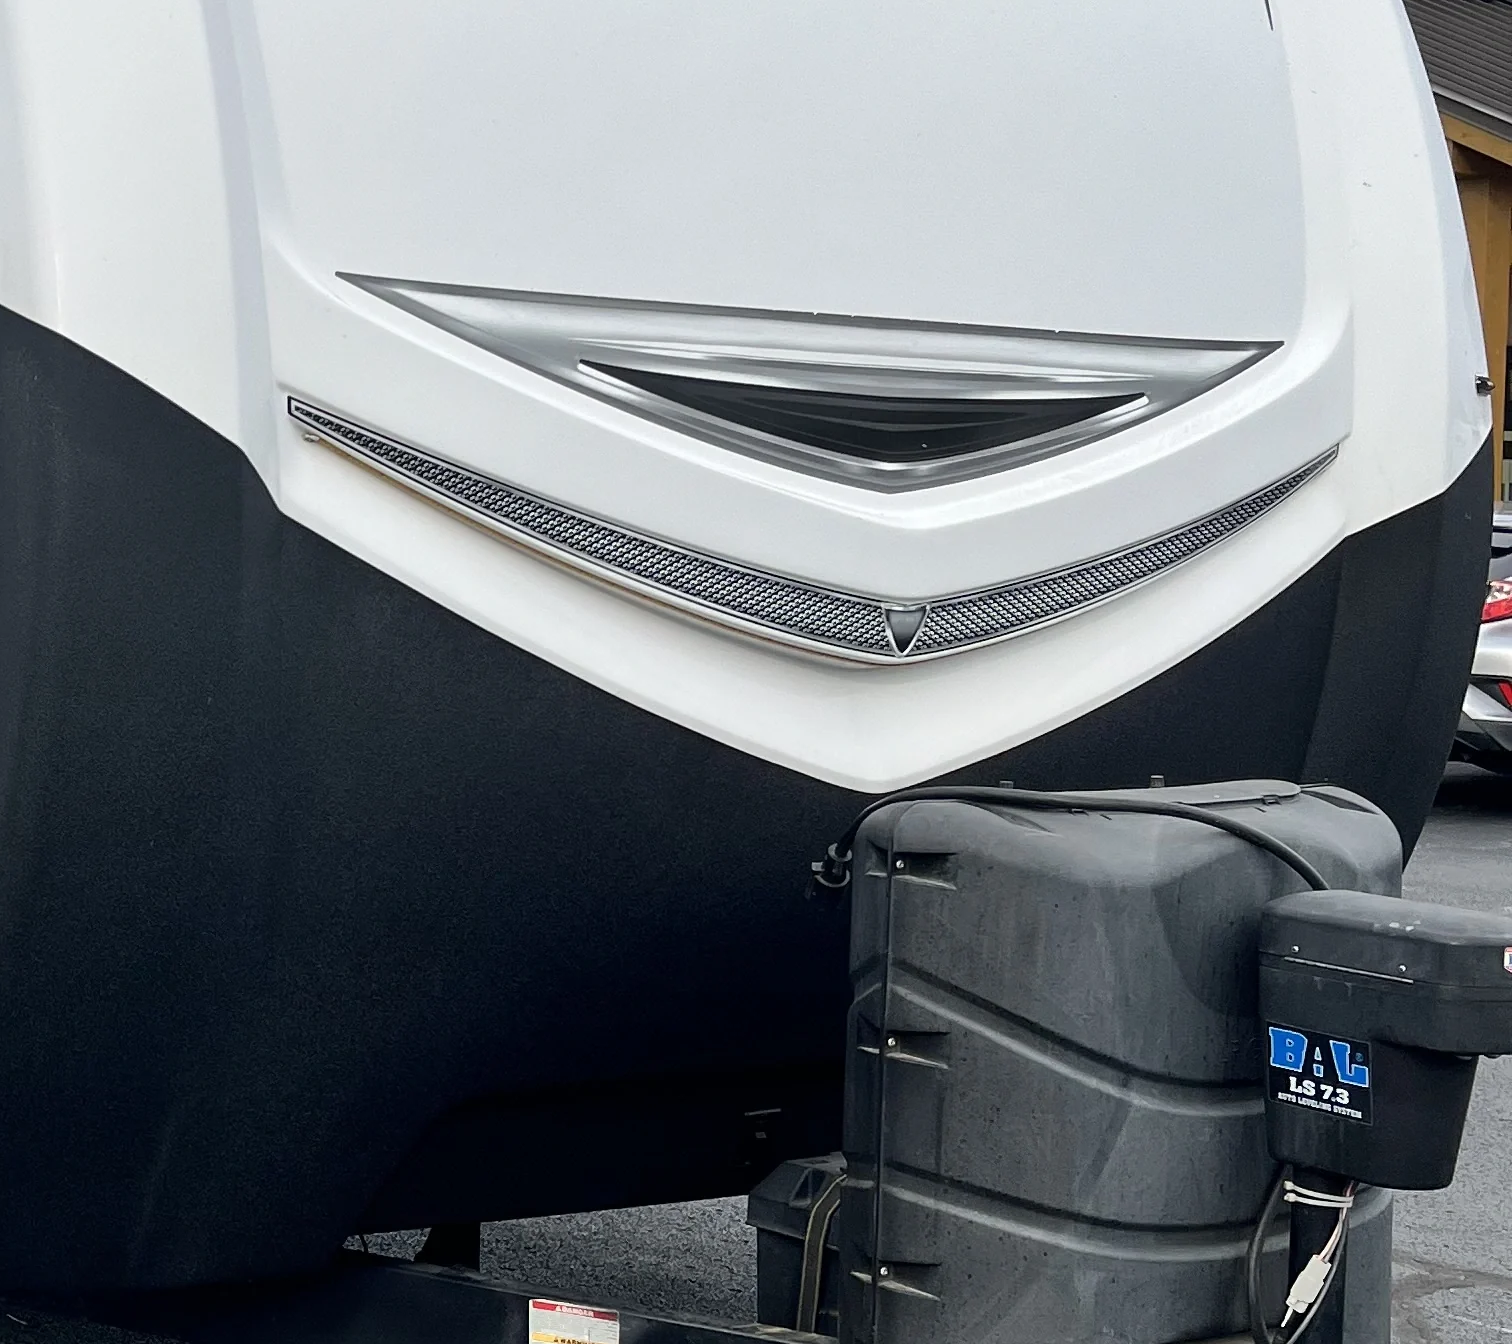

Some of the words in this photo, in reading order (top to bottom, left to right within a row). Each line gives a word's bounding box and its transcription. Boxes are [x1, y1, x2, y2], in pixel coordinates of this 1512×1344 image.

[1268, 1026, 1370, 1088] BAL
[1289, 1076, 1316, 1097] LS
[1319, 1083, 1350, 1105] 7.3
